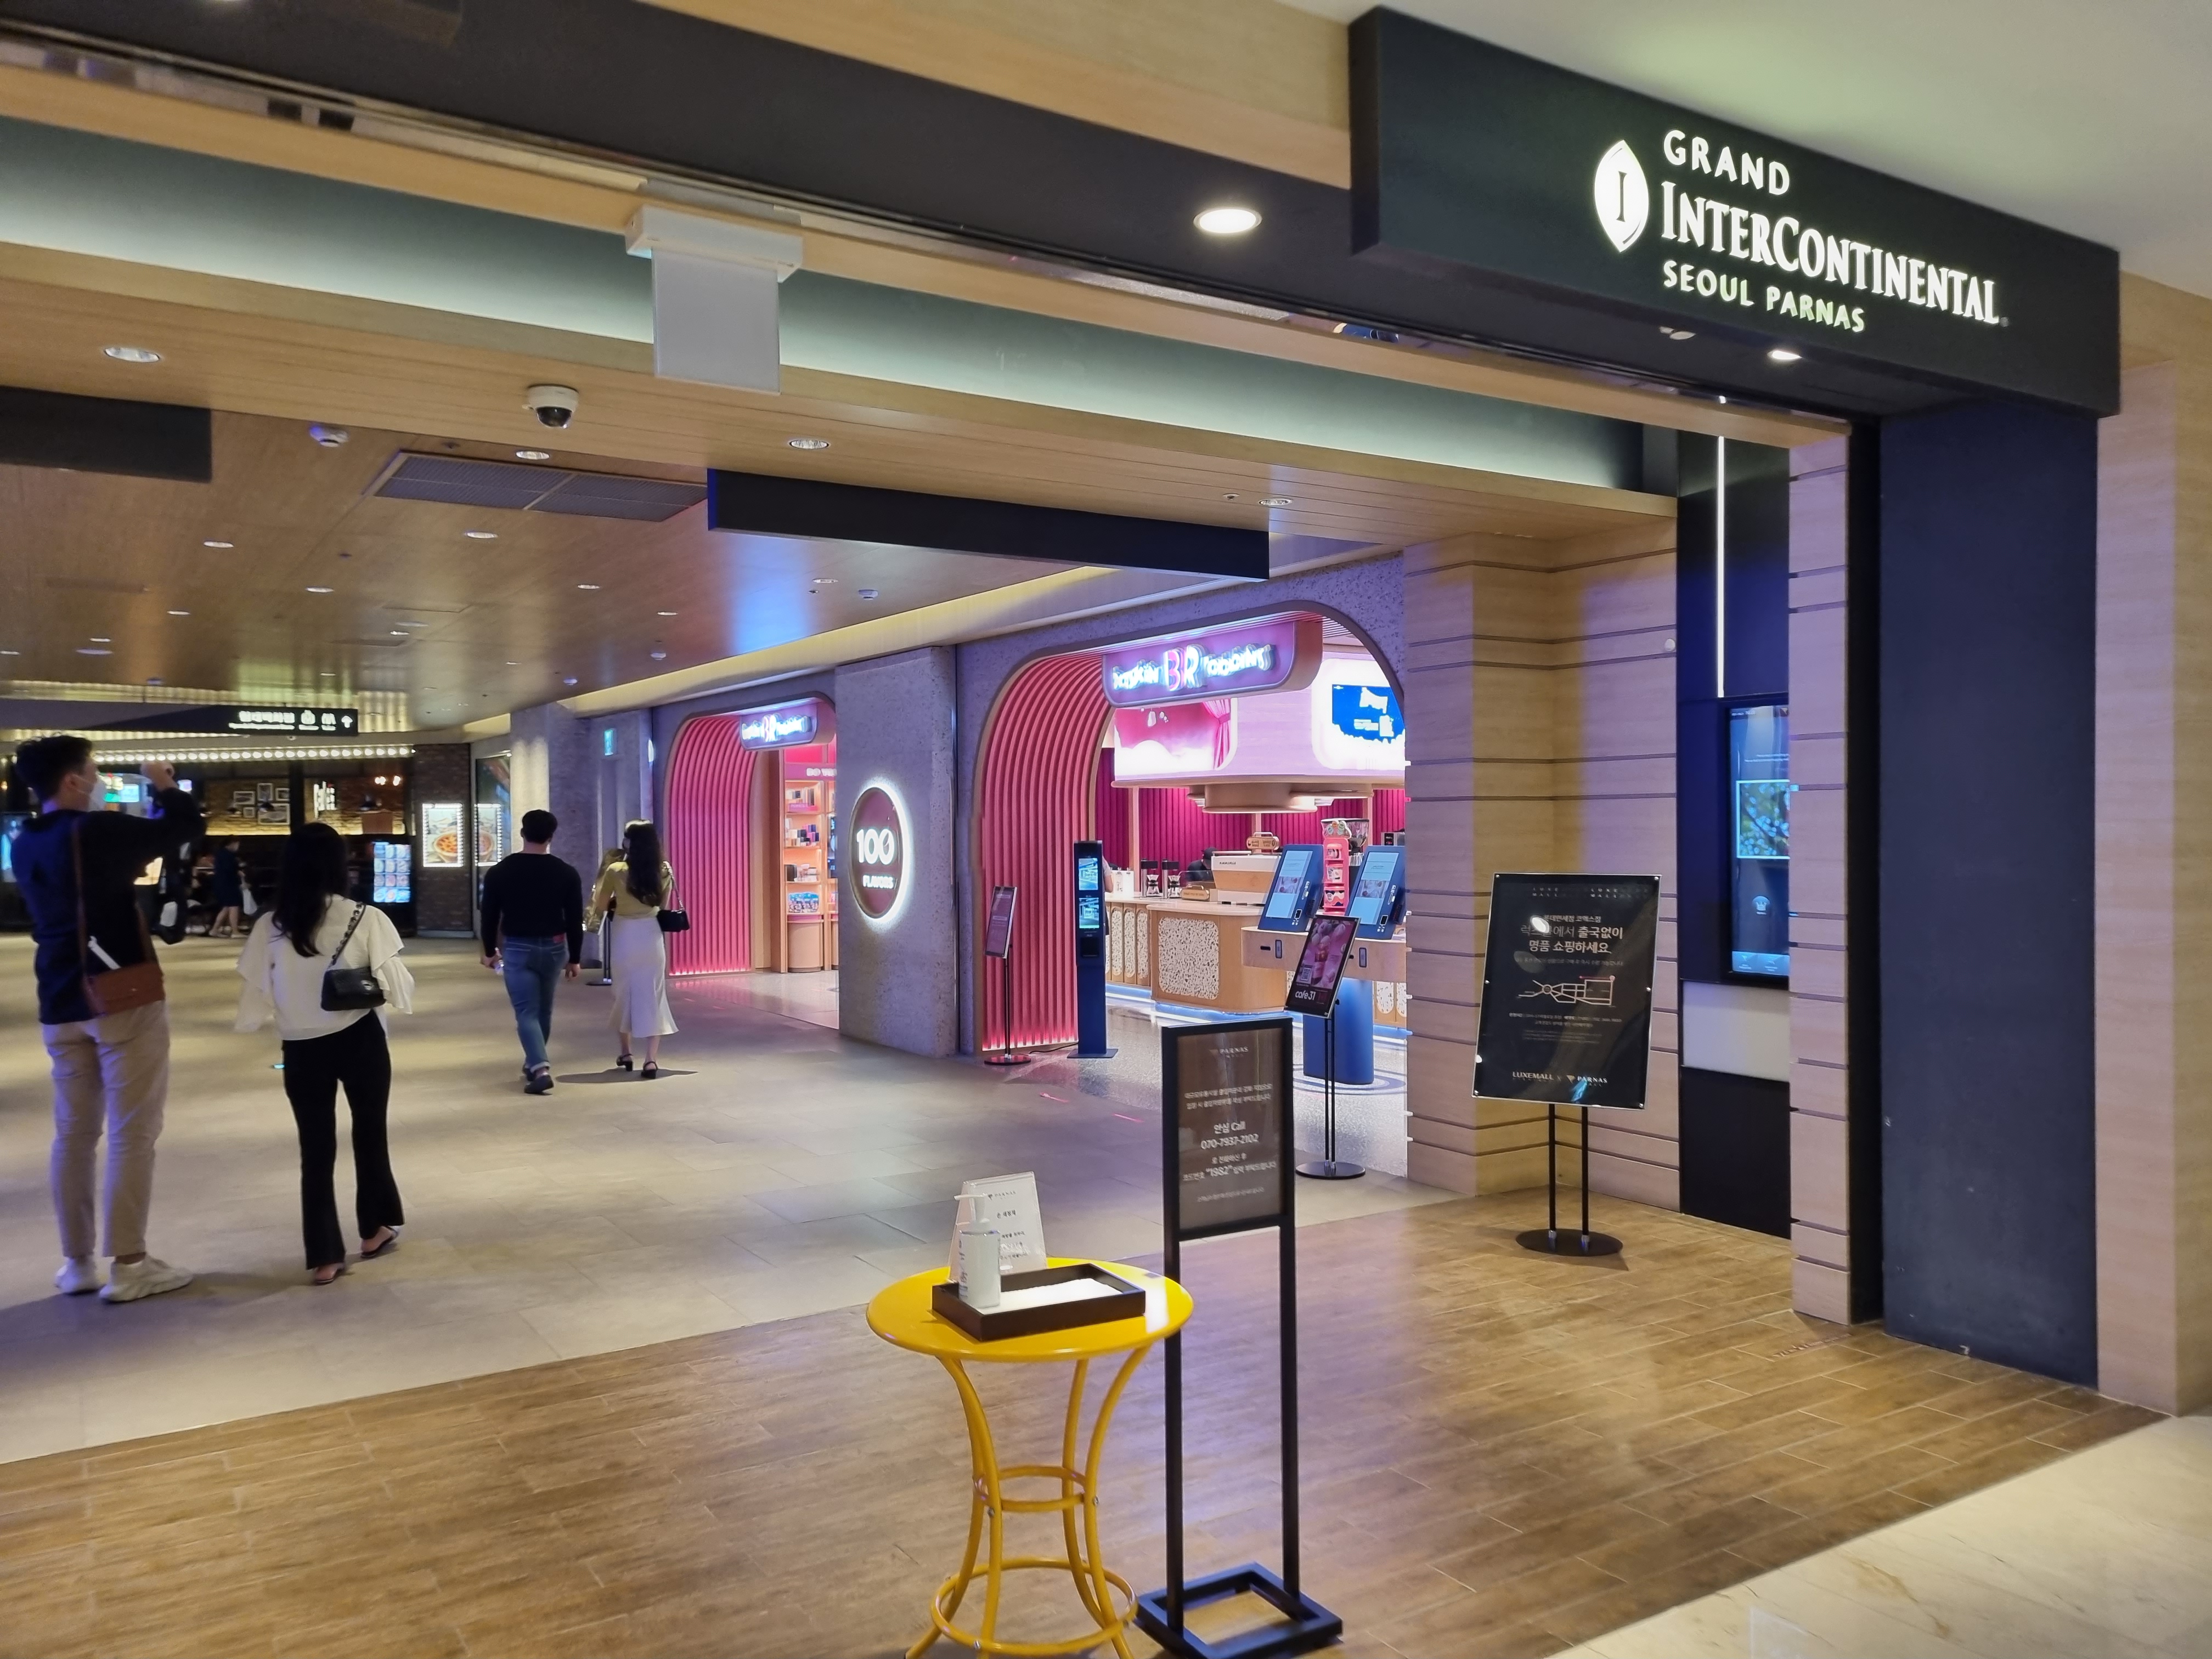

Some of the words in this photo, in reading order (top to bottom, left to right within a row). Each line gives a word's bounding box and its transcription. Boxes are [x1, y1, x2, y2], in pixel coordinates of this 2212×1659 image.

[1663, 129, 1791, 196] GRAND
[1663, 259, 1754, 307] SEOUL
[1767, 285, 1865, 334] PARNAS
[1164, 644, 1203, 691] BR
[856, 828, 895, 865] 100
[1529, 940, 1550, 952] 명품
[1577, 926, 1623, 940] 출국없이
[1231, 1120, 1246, 1131] Call
